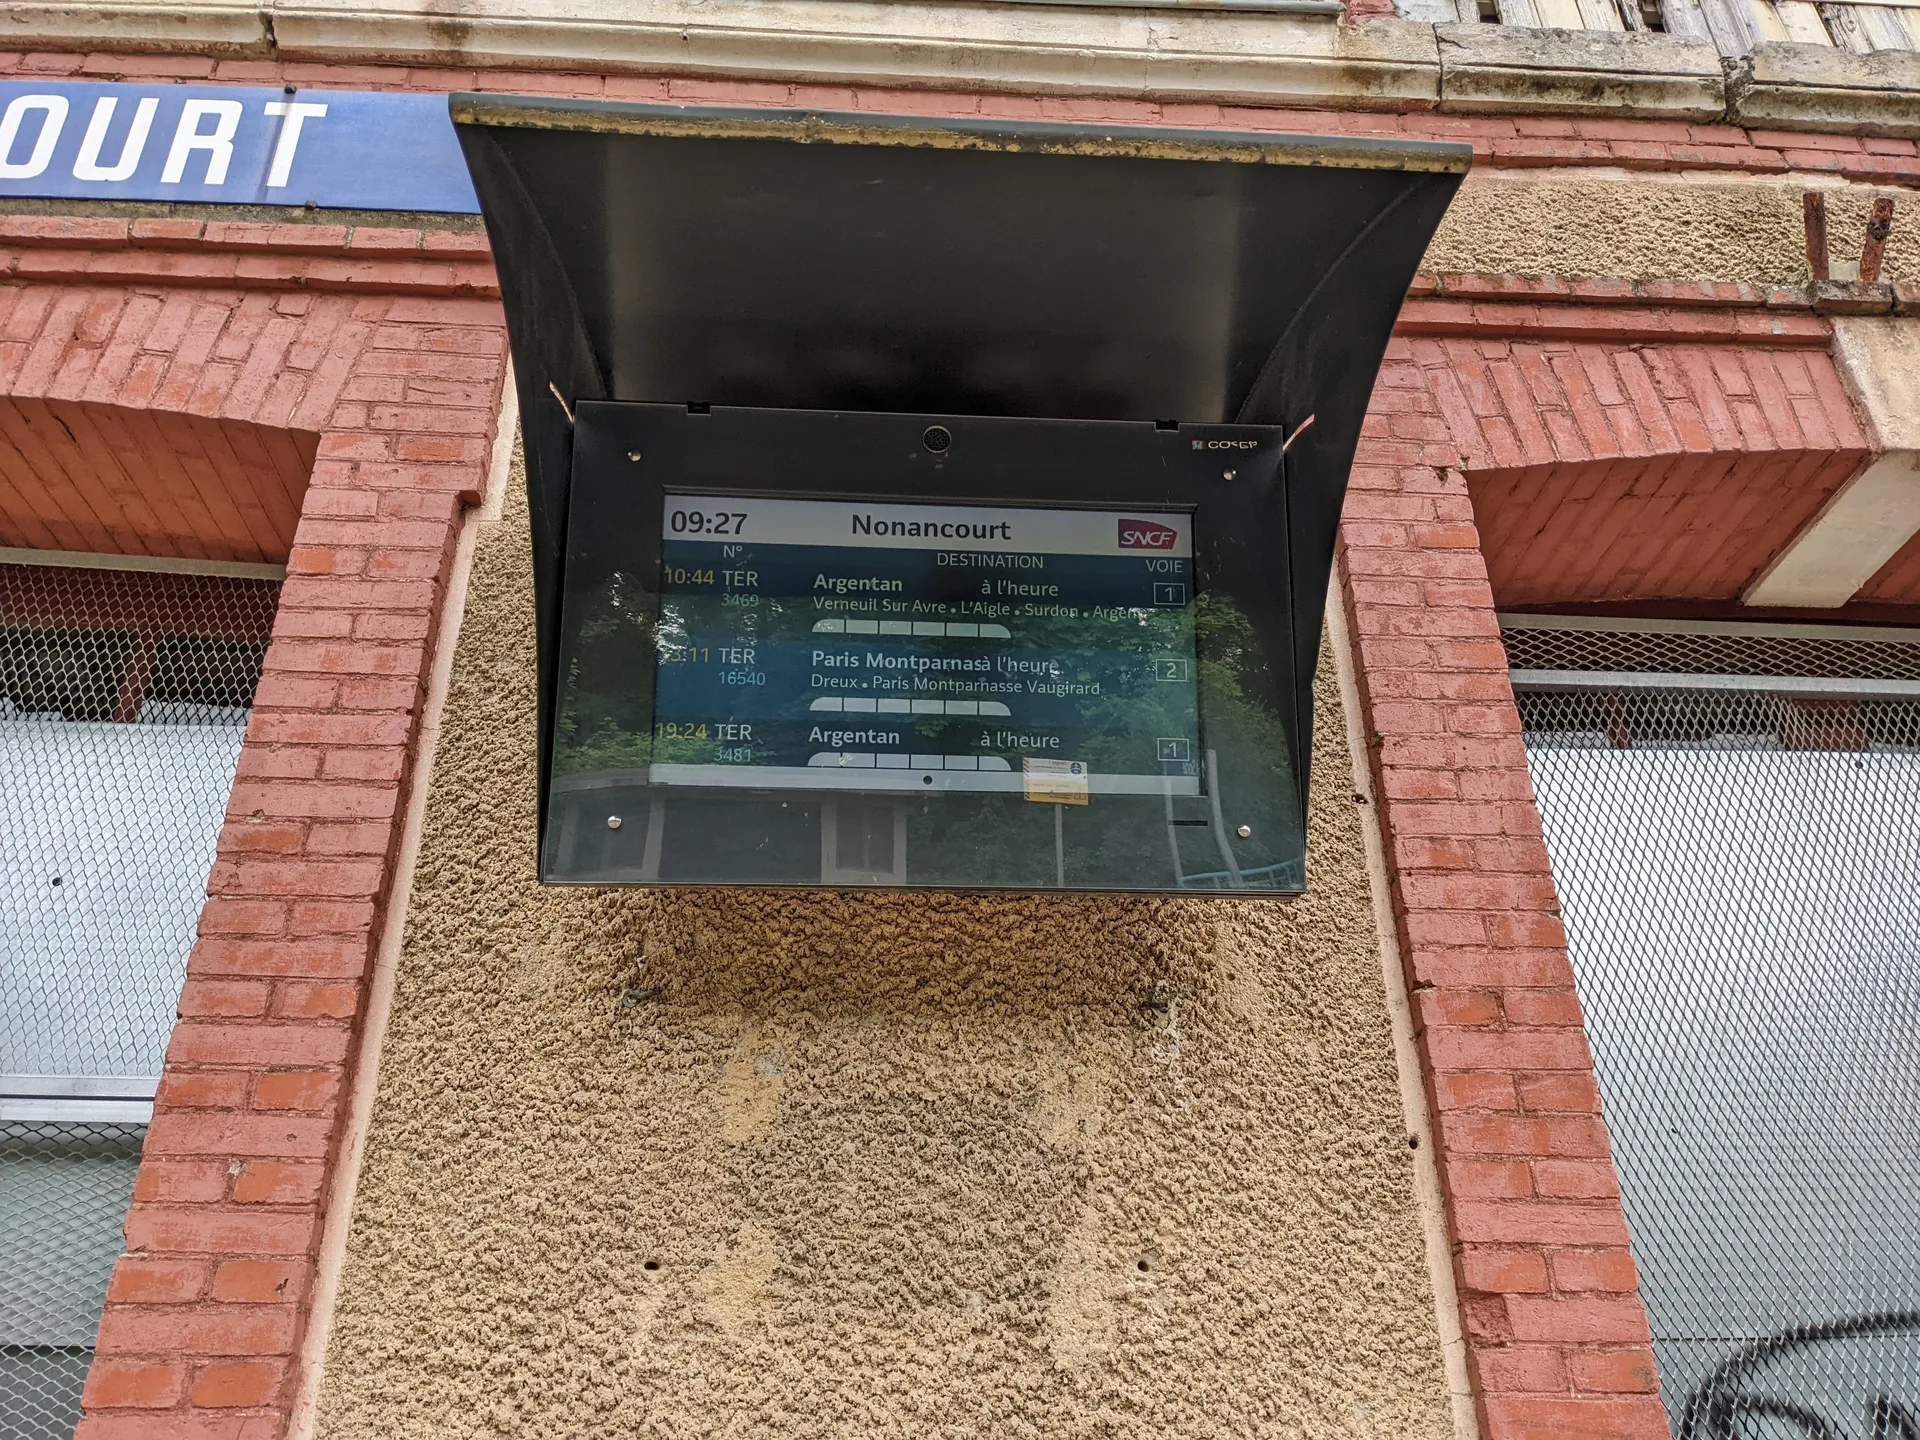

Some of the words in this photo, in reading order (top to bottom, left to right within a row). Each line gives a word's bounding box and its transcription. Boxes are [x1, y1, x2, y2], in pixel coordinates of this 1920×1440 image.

[0, 95, 328, 187] OURT
[671, 510, 748, 535] 09:27
[852, 514, 1011, 540] Nonancourt
[1121, 531, 1173, 546] SNCF
[723, 544, 743, 559] N°
[937, 553, 1044, 569] DESTINATION
[1145, 559, 1183, 573] VOIE
[666, 568, 715, 585] 10:44
[722, 570, 758, 587] TER
[813, 573, 903, 594] Argentan
[981, 579, 991, 595] à
[997, 579, 1059, 597] l'heure
[1164, 586, 1174, 602] 1
[721, 593, 759, 608] 3469
[813, 596, 878, 612] Verneuil
[882, 598, 908, 612] Sur
[912, 600, 946, 614] Avre
[961, 602, 1010, 618] L'Aigle
[1024, 603, 1079, 618] Surdon
[664, 647, 710, 664] 3:11
[718, 648, 755, 664] TER
[812, 651, 860, 668] Paris
[866, 652, 982, 673] Montparnas
[982, 655, 991, 671] à
[997, 655, 1059, 673] l'heure
[1166, 662, 1177, 679] 2
[718, 671, 766, 686] 16540
[811, 674, 857, 689] Dreux
[873, 676, 909, 690] Paris
[914, 677, 1022, 694] Montparnasse
[1026, 680, 1100, 697] Vaugirard
[656, 722, 708, 739] 19:24
[715, 723, 752, 740] TER
[808, 726, 900, 747] Argentan
[981, 731, 991, 747] à
[997, 731, 1060, 748] l'heure
[1168, 742, 1178, 758] 1
[714, 748, 752, 762] 3481
